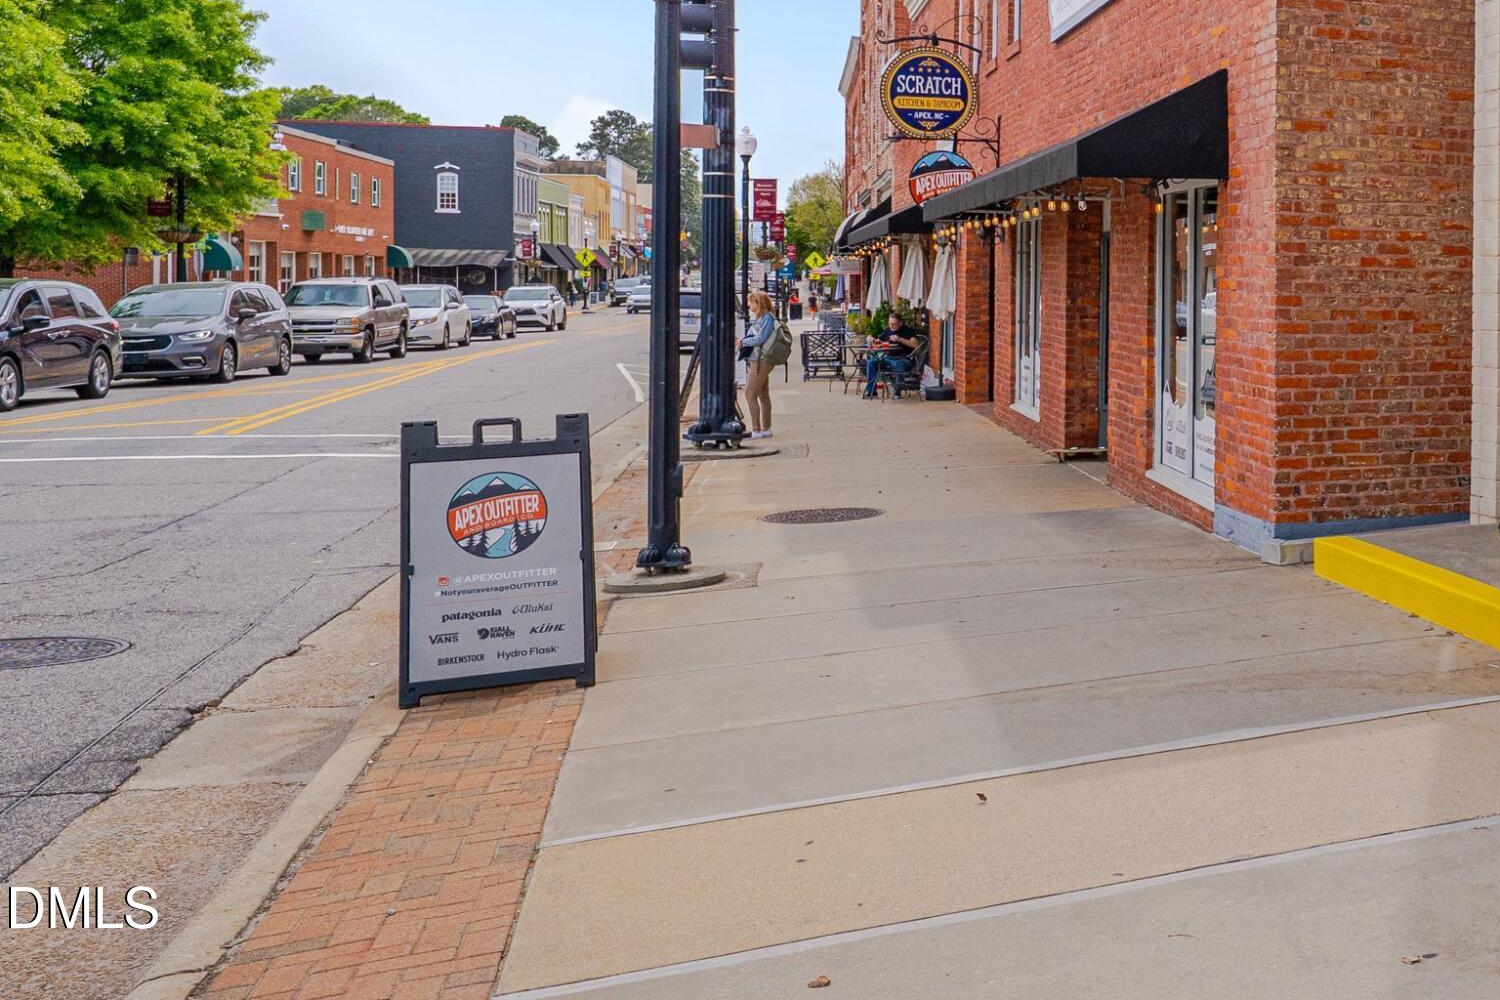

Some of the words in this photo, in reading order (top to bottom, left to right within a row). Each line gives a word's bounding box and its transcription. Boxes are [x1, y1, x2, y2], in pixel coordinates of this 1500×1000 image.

[897, 74, 962, 96] SCRATCH
[934, 112, 944, 120] NC
[916, 175, 936, 195] APEX
[455, 502, 483, 532] APEX
[483, 493, 540, 521] OUTFITTER
[463, 525, 482, 537] AND
[484, 516, 516, 529] BOARD
[455, 567, 557, 584] @APEXOUTFITTER
[434, 580, 559, 597] NotyouraverageOUTFITTER
[441, 607, 502, 623] patagonia
[429, 632, 459, 645] VANS
[437, 653, 486, 666] BIRKENSTOCK
[497, 649, 528, 661] Hydro
[529, 646, 556, 656] Flask
